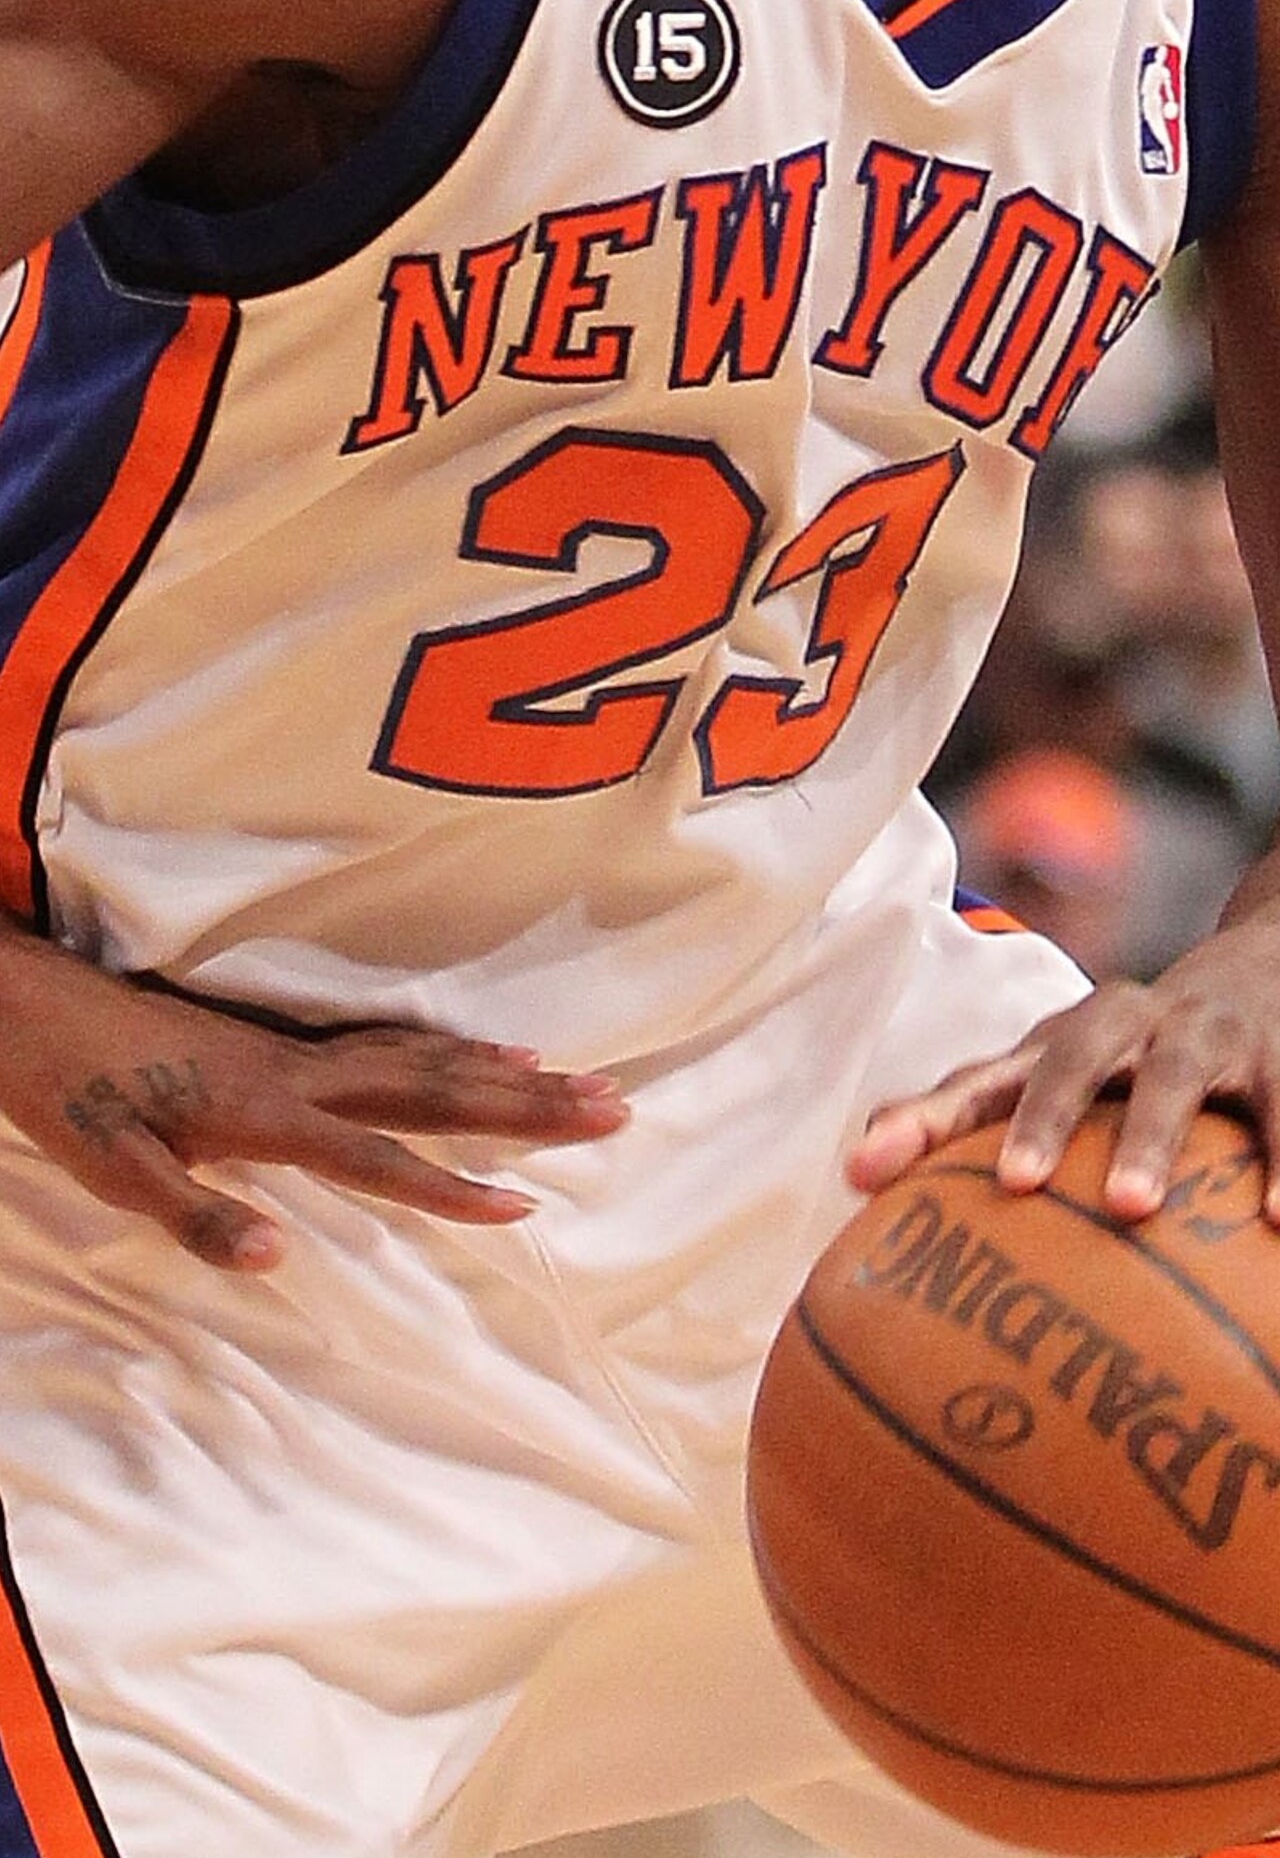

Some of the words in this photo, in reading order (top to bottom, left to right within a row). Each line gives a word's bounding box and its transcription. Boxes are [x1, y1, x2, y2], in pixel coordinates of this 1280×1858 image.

[632, 10, 707, 82] 15
[339, 140, 830, 454] NEW
[367, 424, 966, 799] 23
